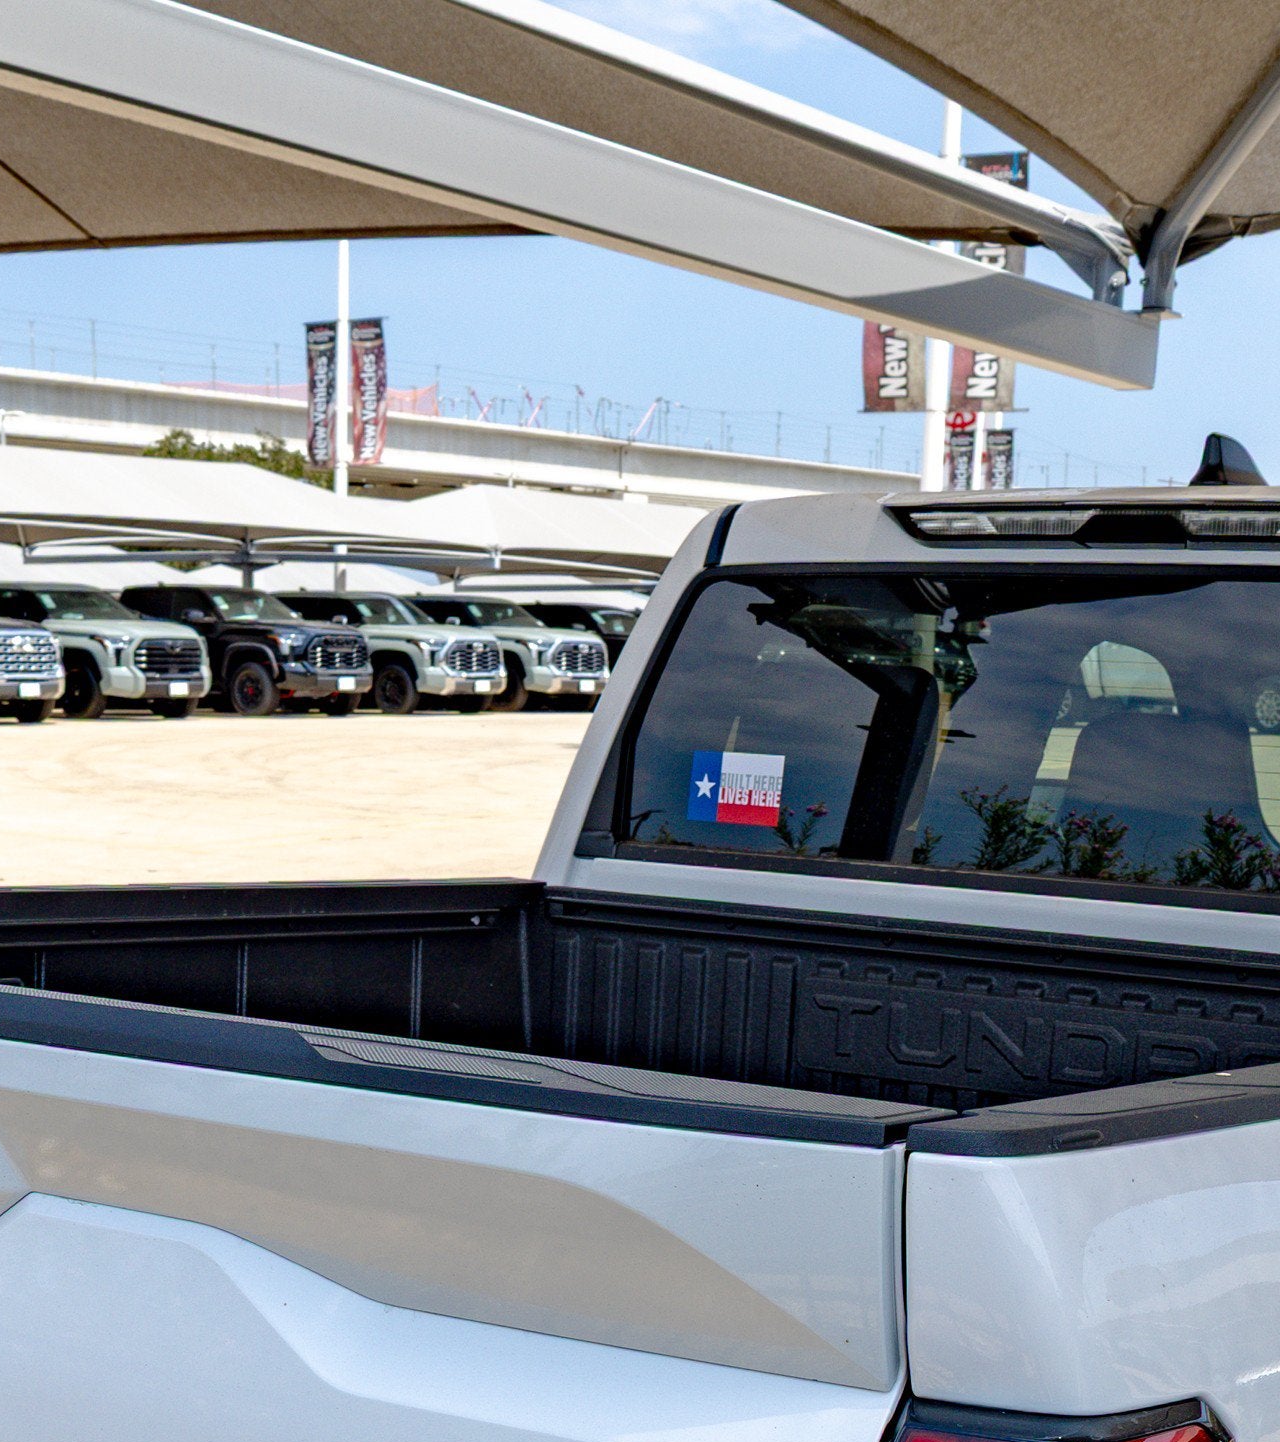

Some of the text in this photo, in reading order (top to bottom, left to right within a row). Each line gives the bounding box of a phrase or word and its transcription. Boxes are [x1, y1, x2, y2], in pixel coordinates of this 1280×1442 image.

[879, 336, 908, 398] New
[313, 355, 329, 422] Vehicles
[360, 353, 377, 421] Vehicles
[313, 425, 329, 461] New
[361, 424, 377, 459] New
[718, 787, 780, 807] LIVES HERE
[721, 773, 783, 791] BUILT HERE
